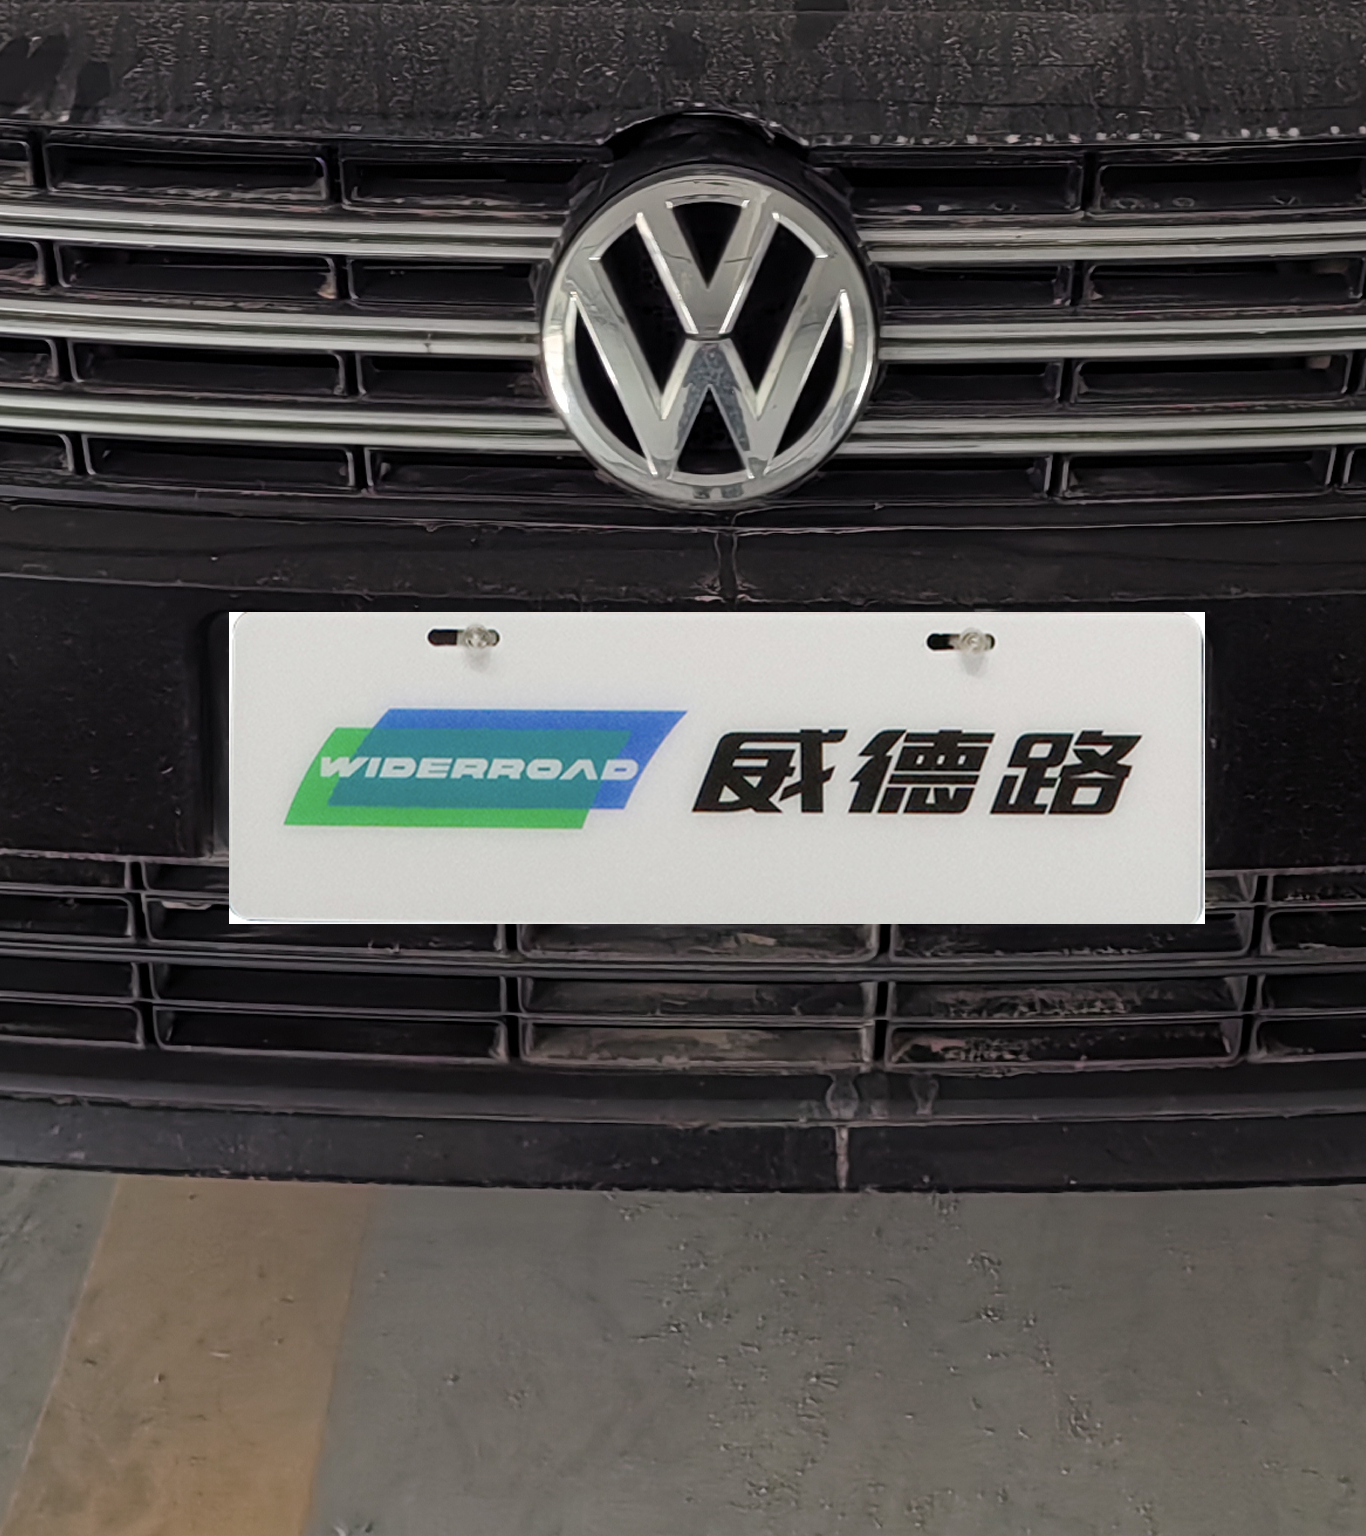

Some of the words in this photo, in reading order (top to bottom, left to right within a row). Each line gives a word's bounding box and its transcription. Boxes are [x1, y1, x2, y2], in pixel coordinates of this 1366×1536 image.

[319, 755, 640, 781] WIDERROAD
[691, 728, 1143, 816] 威德路
